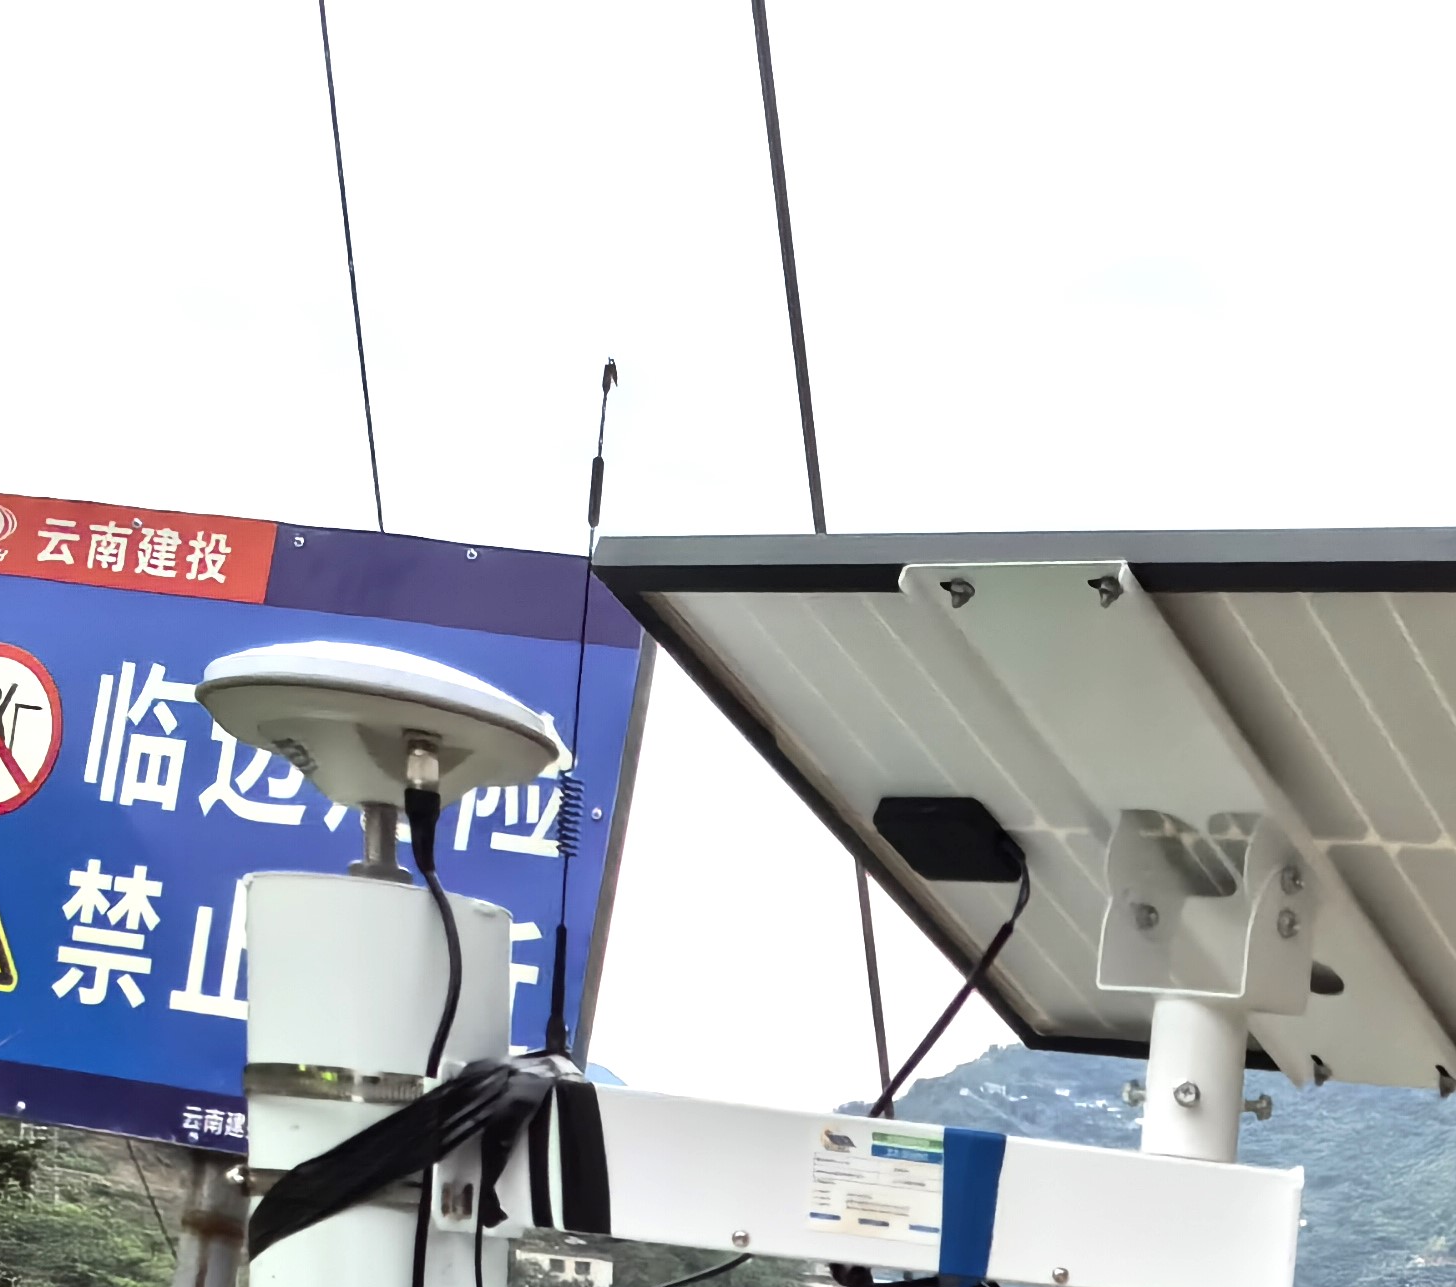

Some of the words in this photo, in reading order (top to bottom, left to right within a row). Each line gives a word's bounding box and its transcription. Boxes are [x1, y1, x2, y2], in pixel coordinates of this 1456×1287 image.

[36, 518, 232, 584] 云南建投
[83, 660, 578, 858] 临边险
[182, 1105, 249, 1140] 云南建
